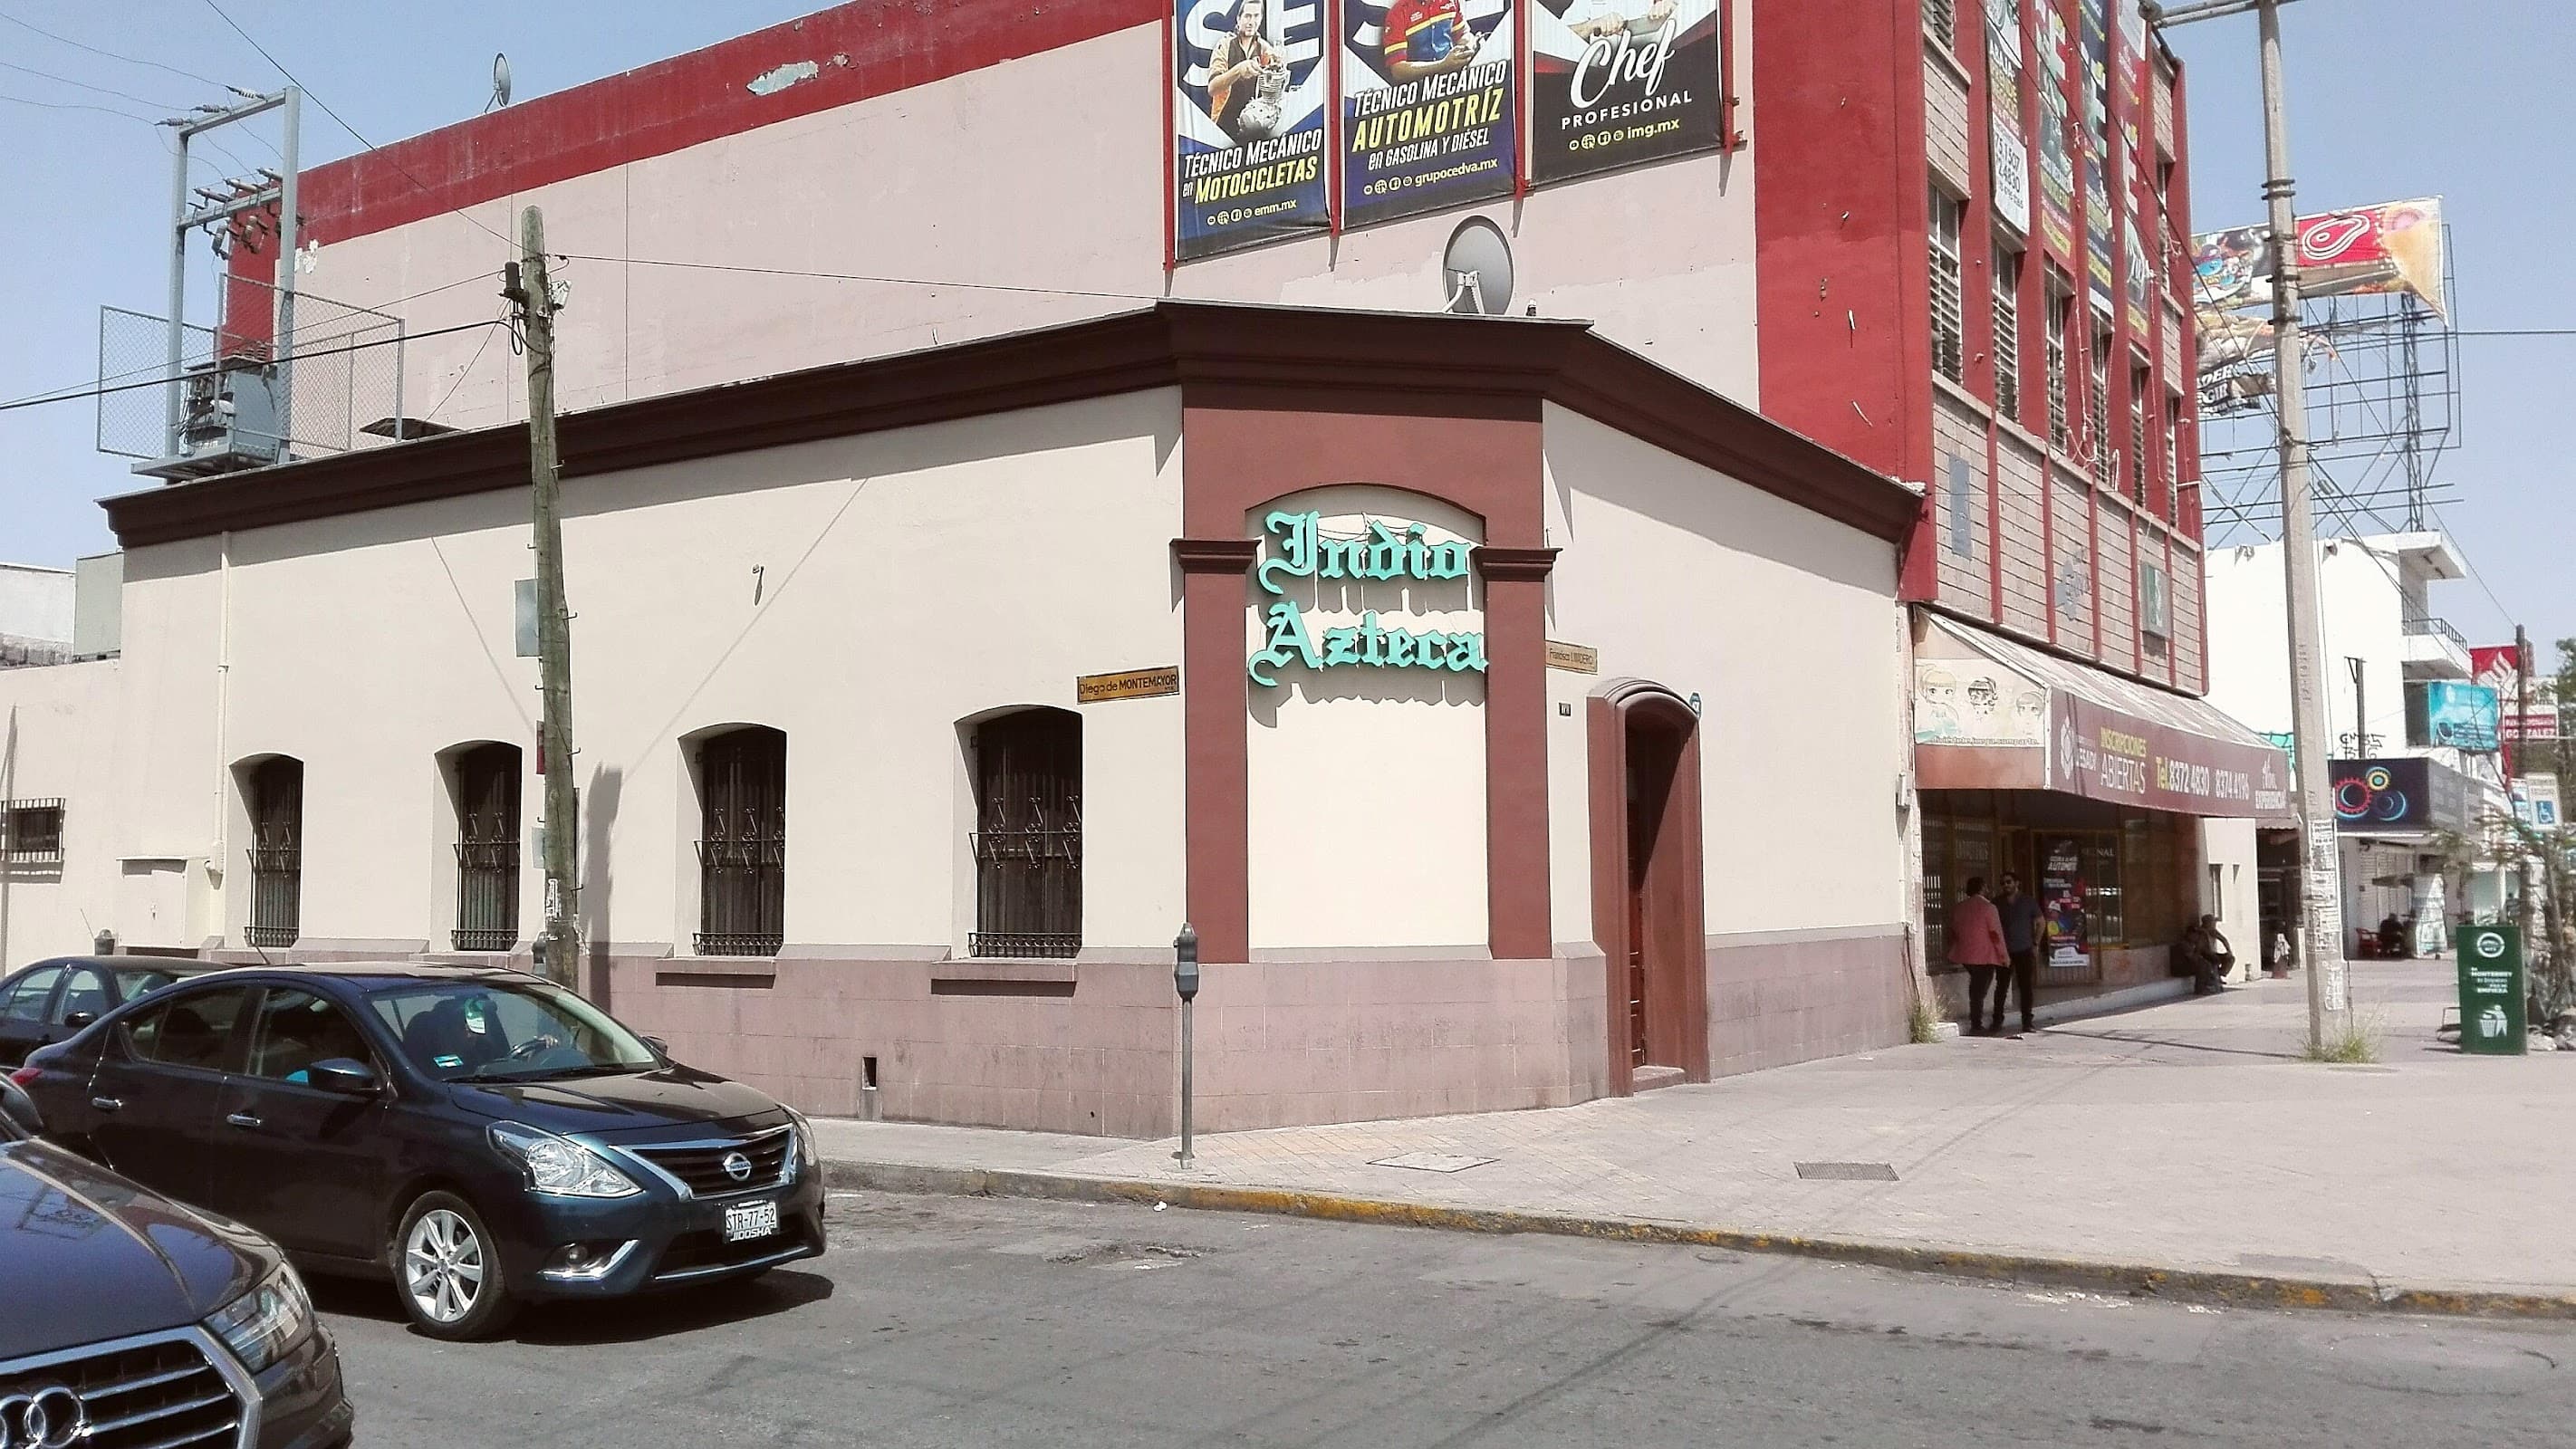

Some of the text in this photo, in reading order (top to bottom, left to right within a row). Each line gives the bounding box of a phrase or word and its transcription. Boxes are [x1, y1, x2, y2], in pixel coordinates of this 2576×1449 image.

[1570, 18, 1676, 108] Chef
[1354, 61, 1506, 118] TÉCNICO MECÁNICO
[1351, 86, 1504, 152] AUTOMOTRÍZ
[1561, 91, 1692, 130] PROFESIONAL
[1628, 119, 1680, 139] img.mx
[1184, 129, 1322, 178] TÉCNICO MECÁNICO
[1368, 128, 1490, 170] en GASOLINA Y DIÉSEL
[1182, 156, 1318, 204] en MOTOCICLETAS
[1415, 158, 1497, 187] grupocedva.mx
[1254, 198, 1297, 216] emm.mx
[1258, 511, 1472, 595] Indio
[1248, 600, 1489, 686] Azteca
[1079, 674, 1177, 695] Diego de MONTEMAYOR
[2505, 728, 2555, 739] GOZALEZ
[2100, 753, 2146, 794] ABIERTAS
[726, 1207, 775, 1231] STR-77-52
